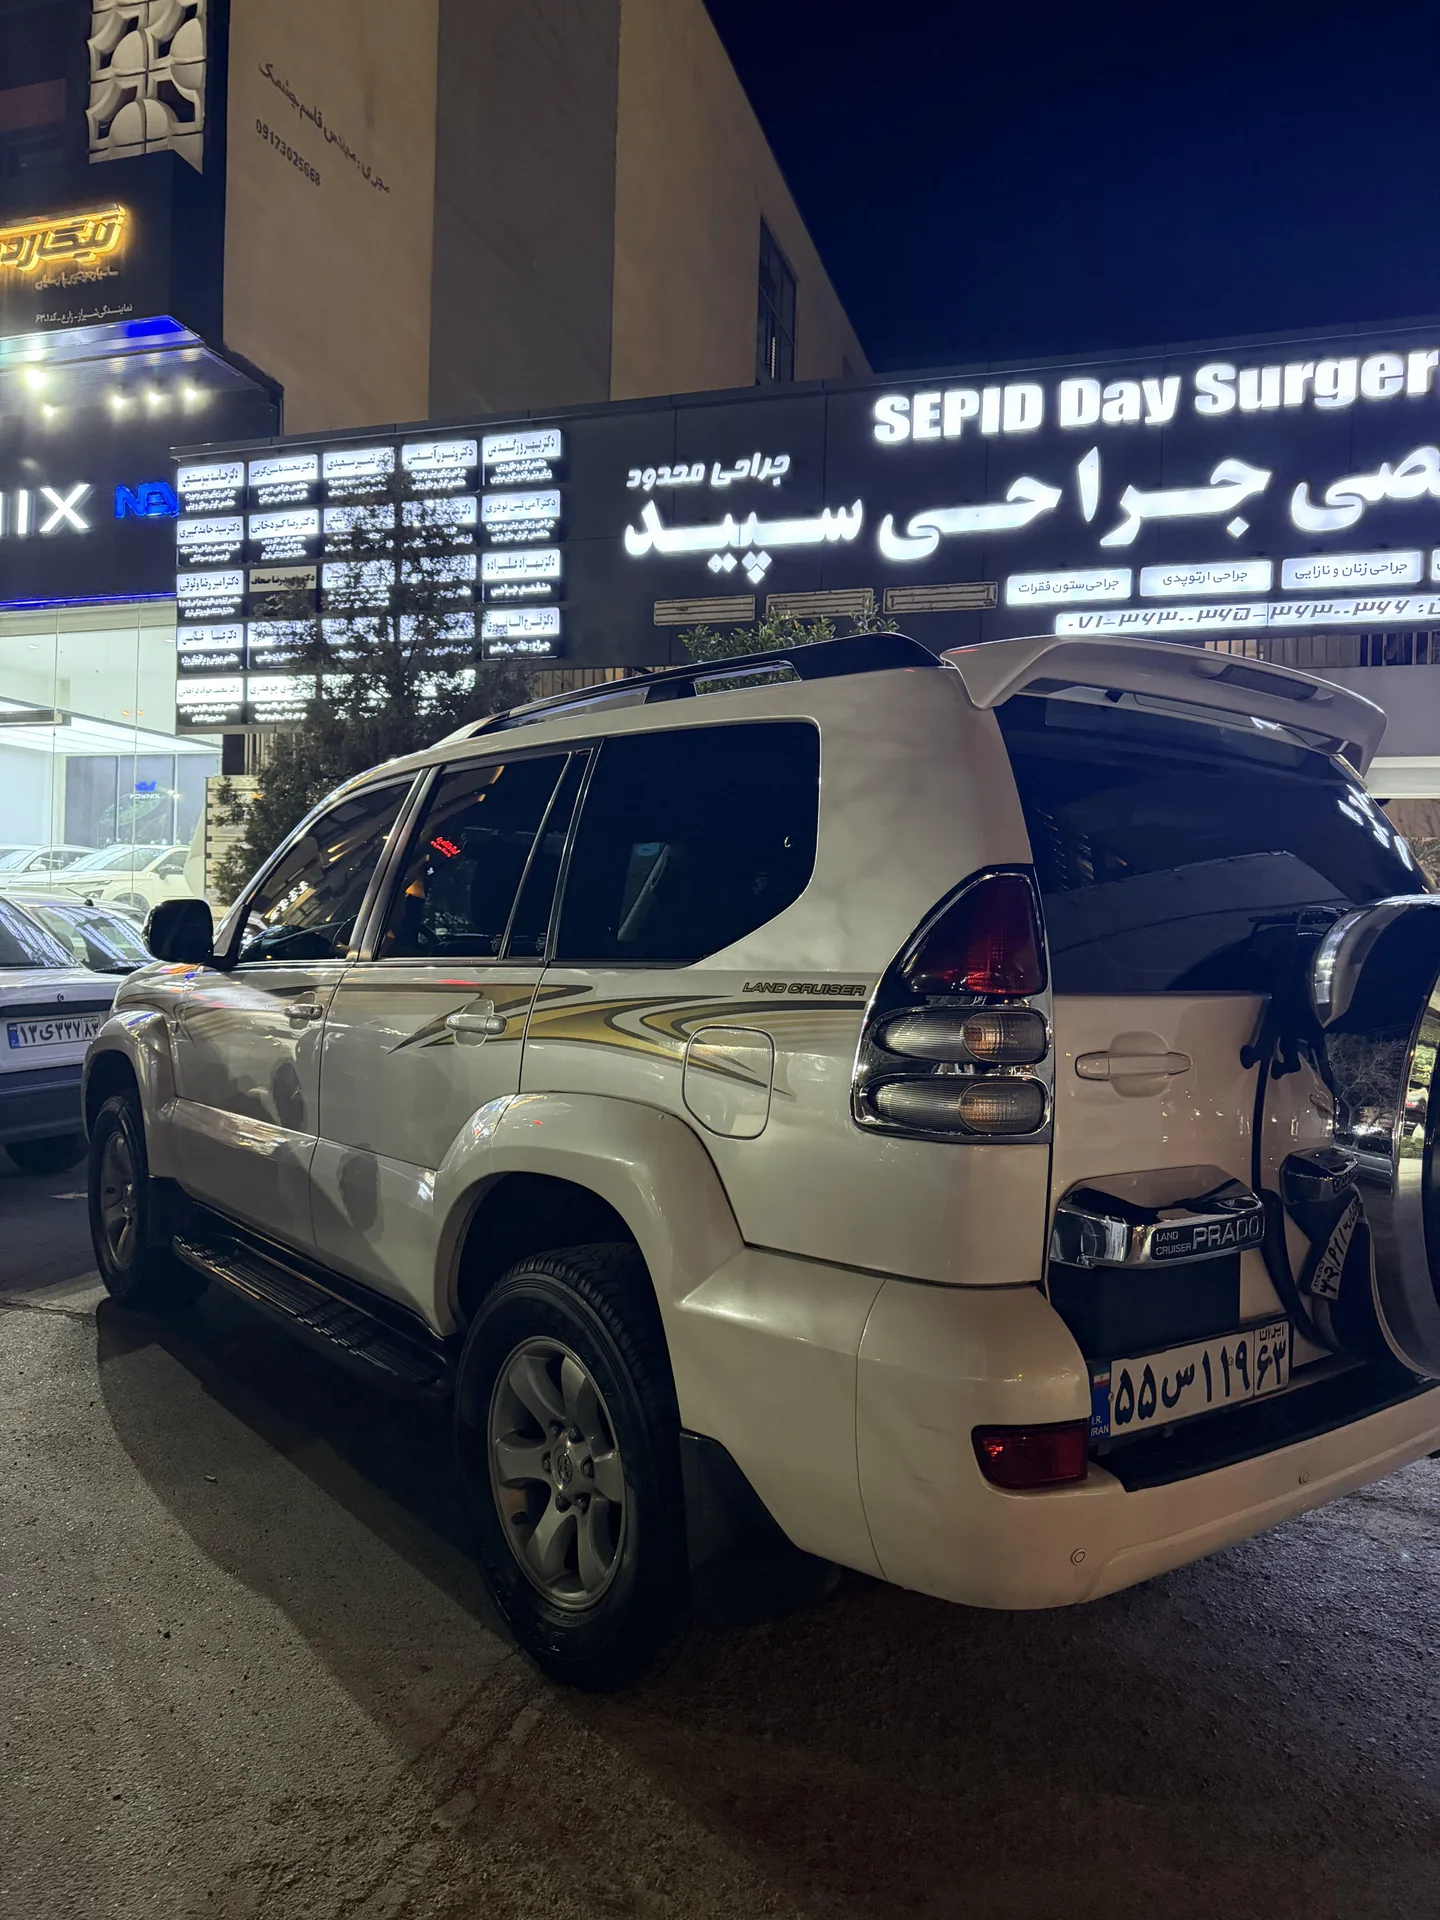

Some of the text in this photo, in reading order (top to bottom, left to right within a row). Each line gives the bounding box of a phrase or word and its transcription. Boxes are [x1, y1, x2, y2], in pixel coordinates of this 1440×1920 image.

[873, 349, 1440, 445] SEPID Day Surger
[626, 452, 791, 491] جراحی محدود
[0, 483, 91, 535] IX
[624, 445, 1440, 585] صی جراحی سپید
[1162, 570, 1248, 587] جراحی ارتوپدی
[1294, 561, 1408, 580] جراحی زنان و نازایی
[1018, 578, 1119, 595] جراحی ستون فقرات
[742, 981, 867, 997] LAND CRUISER
[1156, 1231, 1179, 1242] LAND
[1192, 1215, 1260, 1250] PRADO
[1155, 1242, 1192, 1256] CRUISER
[1259, 1324, 1285, 1342] ایران
[1090, 1425, 1109, 1437] IRAN
